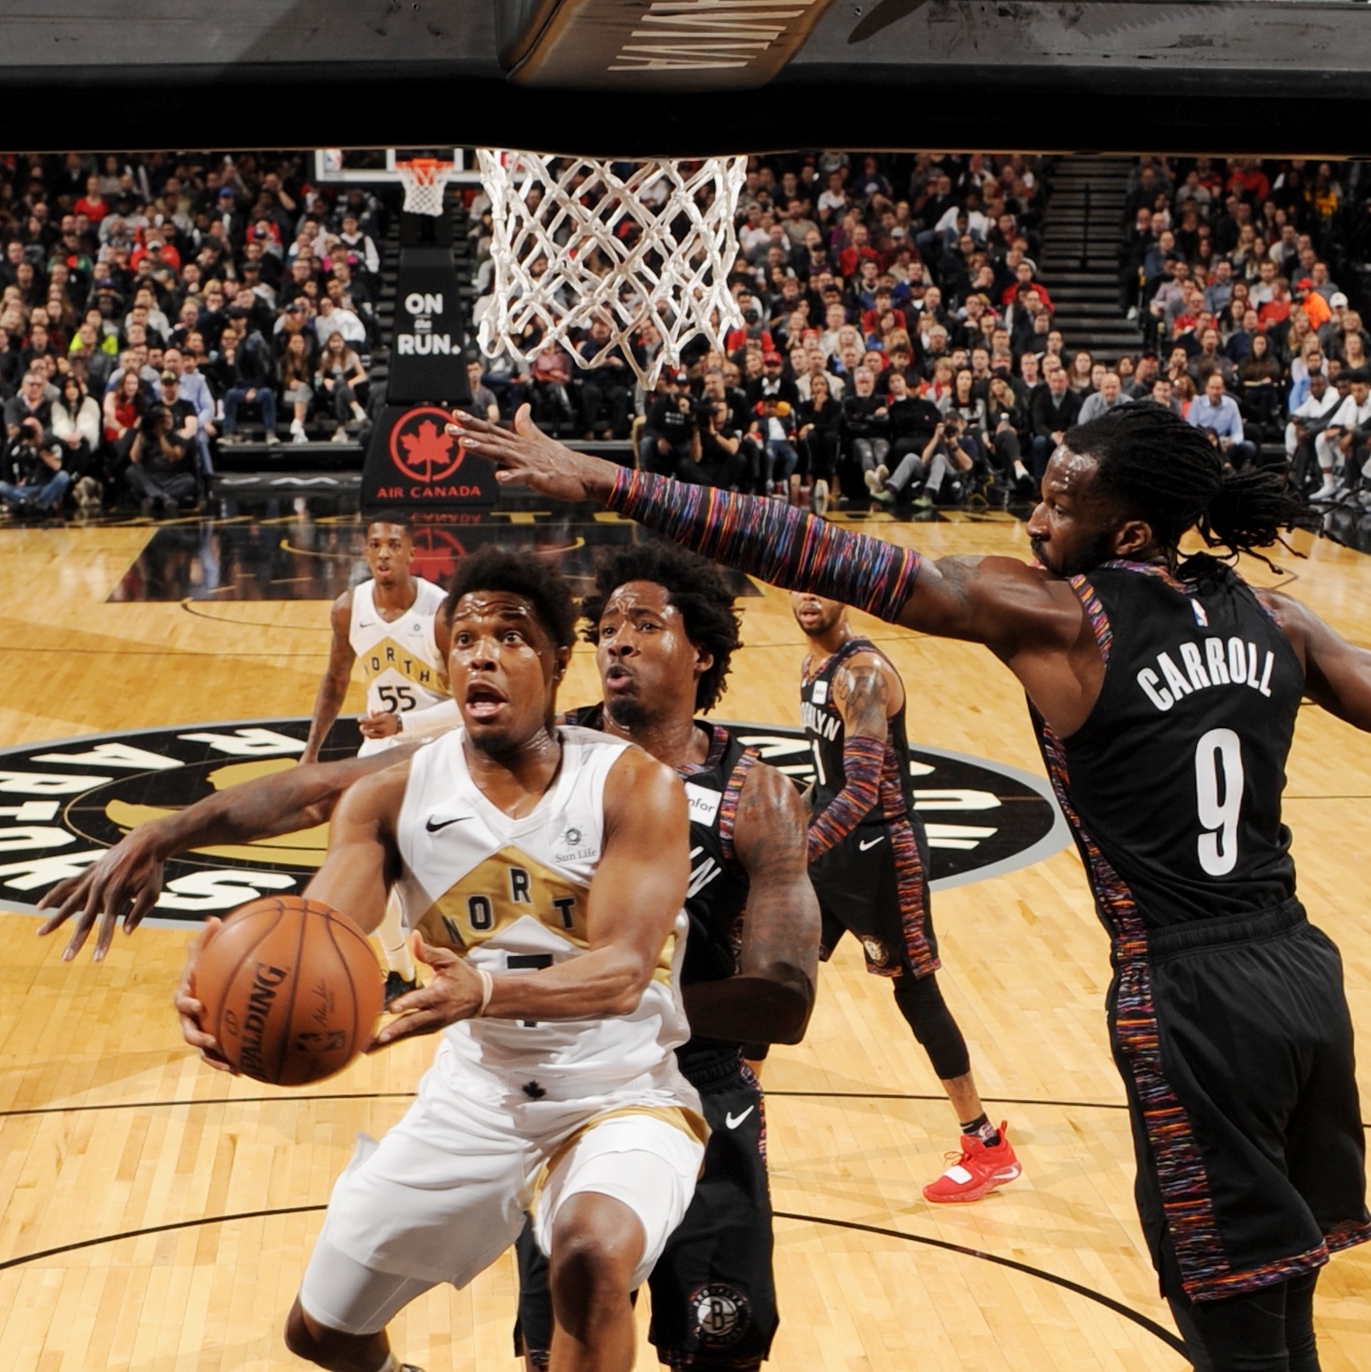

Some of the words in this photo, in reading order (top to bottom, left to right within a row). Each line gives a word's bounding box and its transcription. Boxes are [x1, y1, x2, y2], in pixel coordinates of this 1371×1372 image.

[404, 293, 443, 315] ON
[376, 487, 404, 498] AIR
[411, 486, 482, 499] CANADA
[1136, 636, 1275, 712] CARROLL
[377, 685, 417, 713] 55
[688, 797, 716, 813] nfor
[1194, 727, 1244, 876] 9
[555, 852, 577, 863] Sun
[578, 847, 597, 859] Life
[440, 866, 576, 948] NORT
